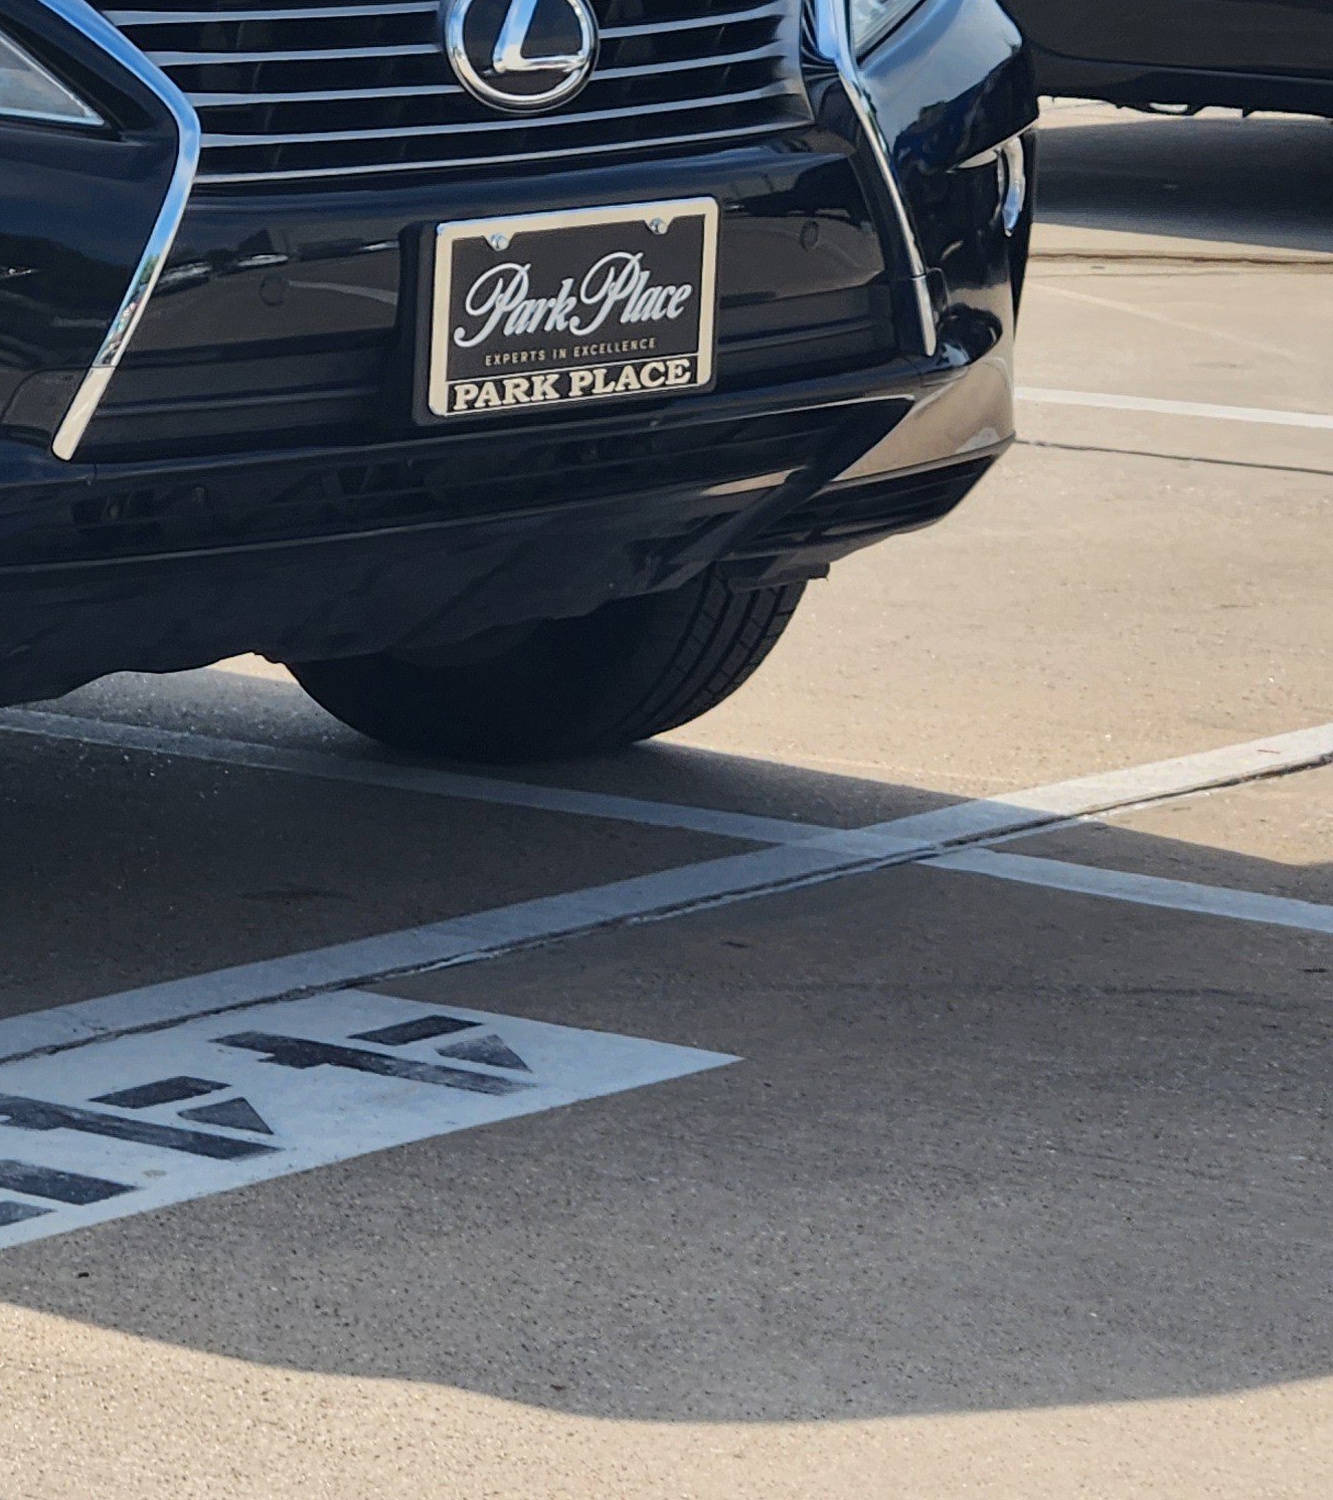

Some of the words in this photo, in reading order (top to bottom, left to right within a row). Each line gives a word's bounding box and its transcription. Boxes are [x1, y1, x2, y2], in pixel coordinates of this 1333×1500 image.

[453, 262, 578, 348] Park
[568, 251, 692, 336] Place
[485, 350, 546, 367] EXPERTS
[552, 348, 567, 360] IN
[573, 337, 656, 358] EXCELLENCE
[452, 372, 560, 411] PARK
[568, 358, 691, 397] PLACE
